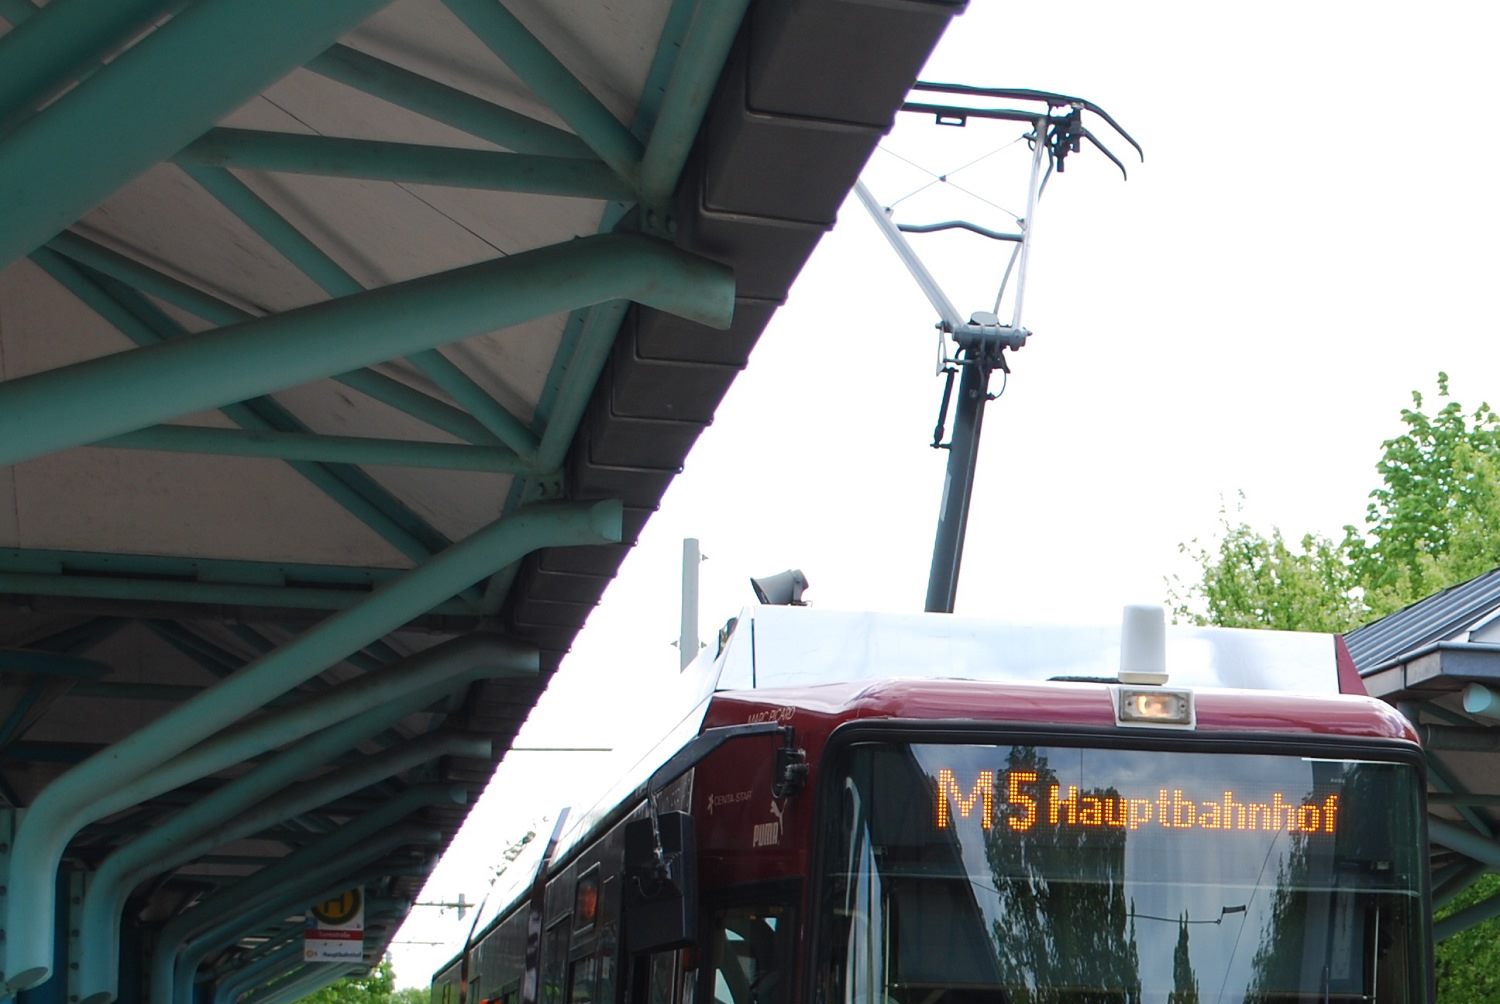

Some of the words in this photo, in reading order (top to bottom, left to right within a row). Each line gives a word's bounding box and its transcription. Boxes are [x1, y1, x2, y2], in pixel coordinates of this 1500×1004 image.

[937, 768, 992, 830] M
[1008, 771, 1038, 831] 5
[1049, 784, 1340, 834] Hauptbahnhof
[753, 822, 778, 848] PUMA
